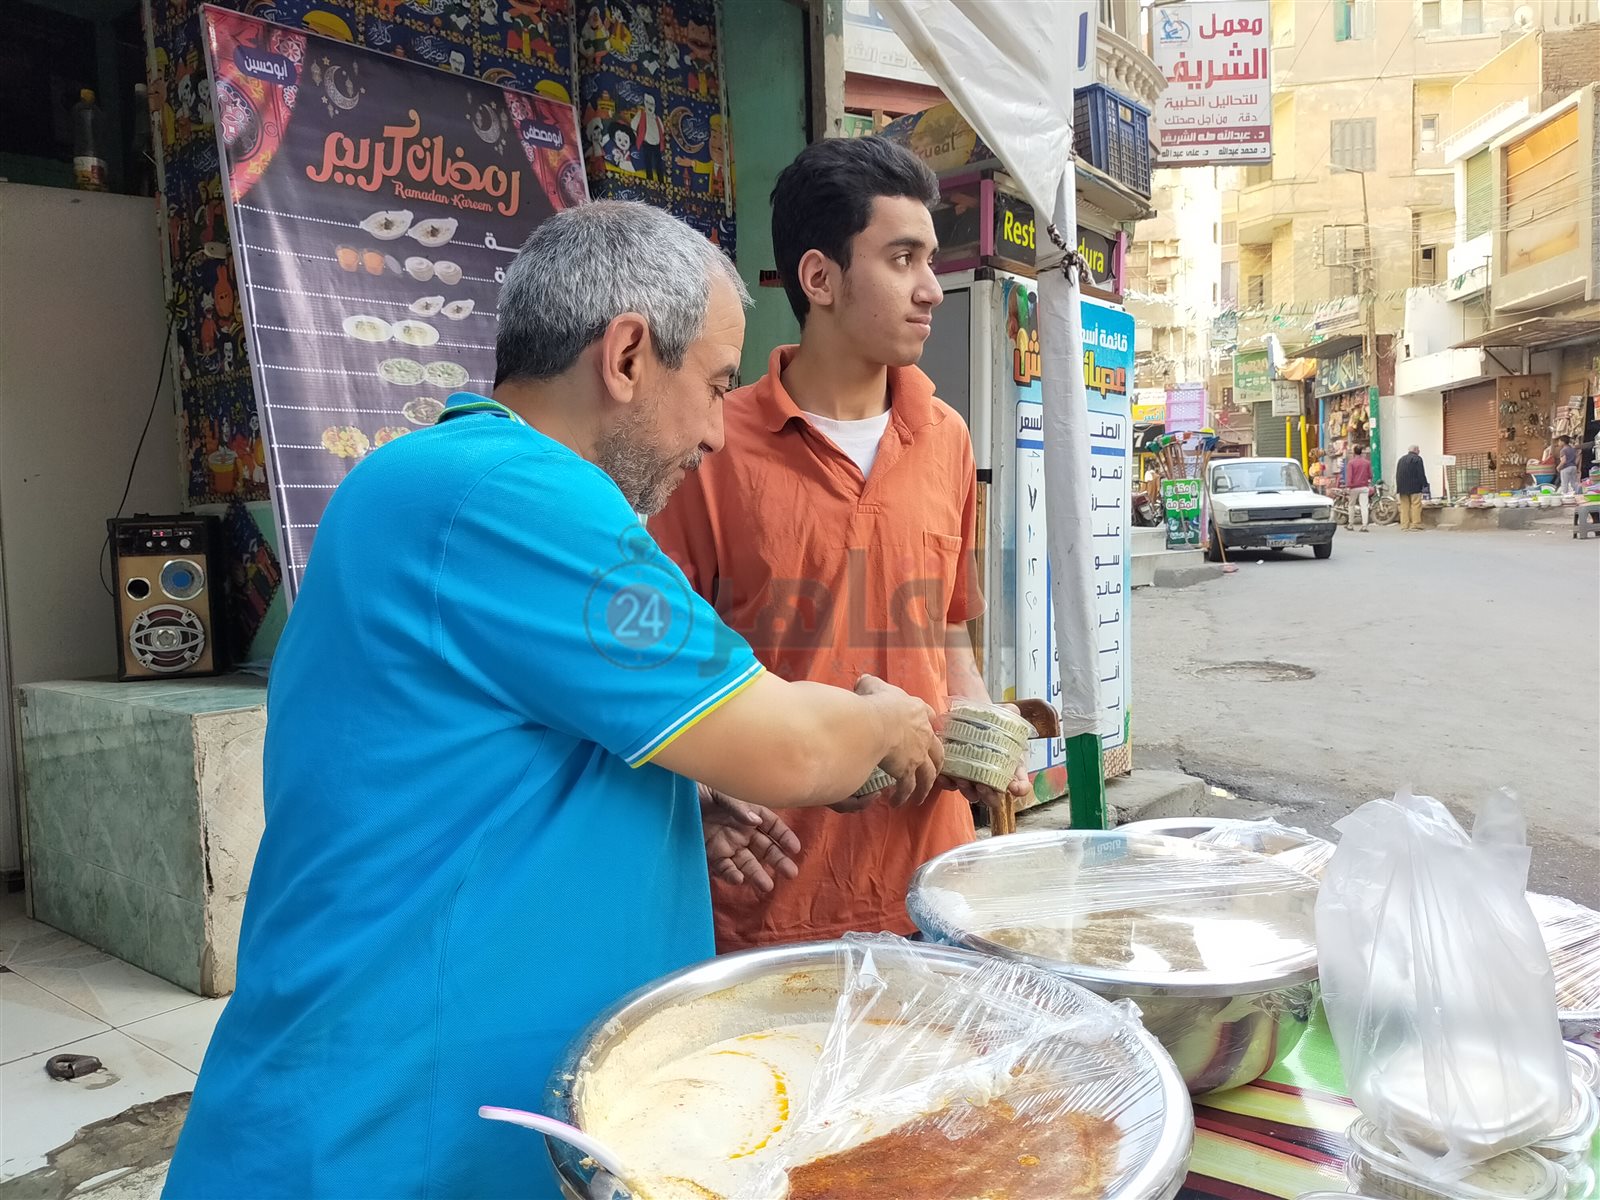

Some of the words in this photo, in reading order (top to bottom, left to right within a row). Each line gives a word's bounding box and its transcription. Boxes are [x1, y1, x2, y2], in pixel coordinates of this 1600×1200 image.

[1200, 13, 1262, 40] معمل
[244, 56, 288, 81] ابوحسين
[1158, 42, 1267, 89] الشريف
[1165, 96, 1205, 111] الطبية
[1209, 94, 1258, 109] للتحاليل
[1165, 115, 1196, 126] صحتك
[1216, 115, 1228, 125] من
[1238, 113, 1257, 122] دقة
[1161, 130, 1197, 145] الشريف
[1198, 131, 1215, 142] طه
[306, 109, 421, 192] كريم
[1240, 147, 1258, 155] محمد
[406, 136, 521, 217] رمضان
[392, 179, 450, 205] Ramadan
[449, 190, 493, 213] Kareem
[1100, 329, 1128, 352] قائمة
[1019, 414, 1042, 433] لسعر
[1090, 422, 1120, 440] الصن
